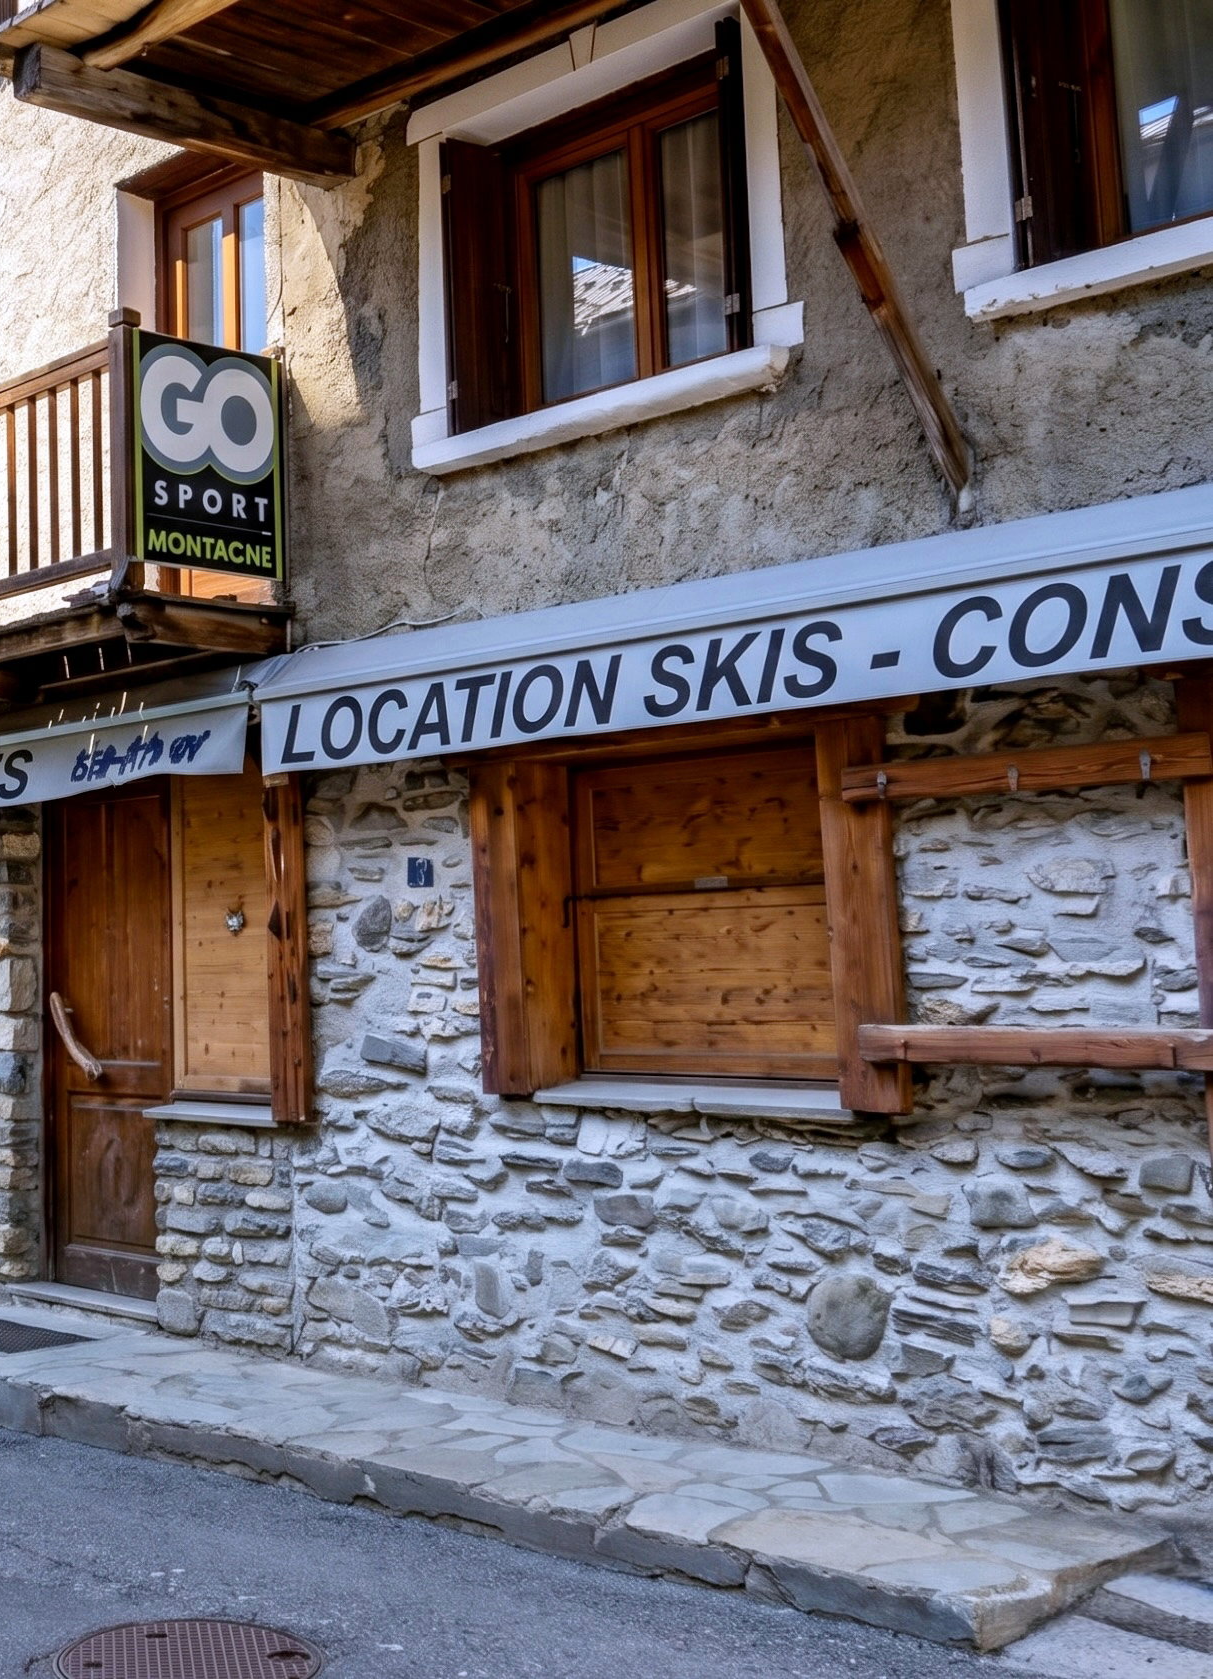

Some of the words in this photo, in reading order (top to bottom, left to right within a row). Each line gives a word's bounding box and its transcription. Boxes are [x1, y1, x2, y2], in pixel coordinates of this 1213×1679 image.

[140, 355, 275, 473] GO
[154, 480, 269, 522] SPORT
[280, 654, 623, 766] LOCATION
[643, 620, 843, 718] SKIS
